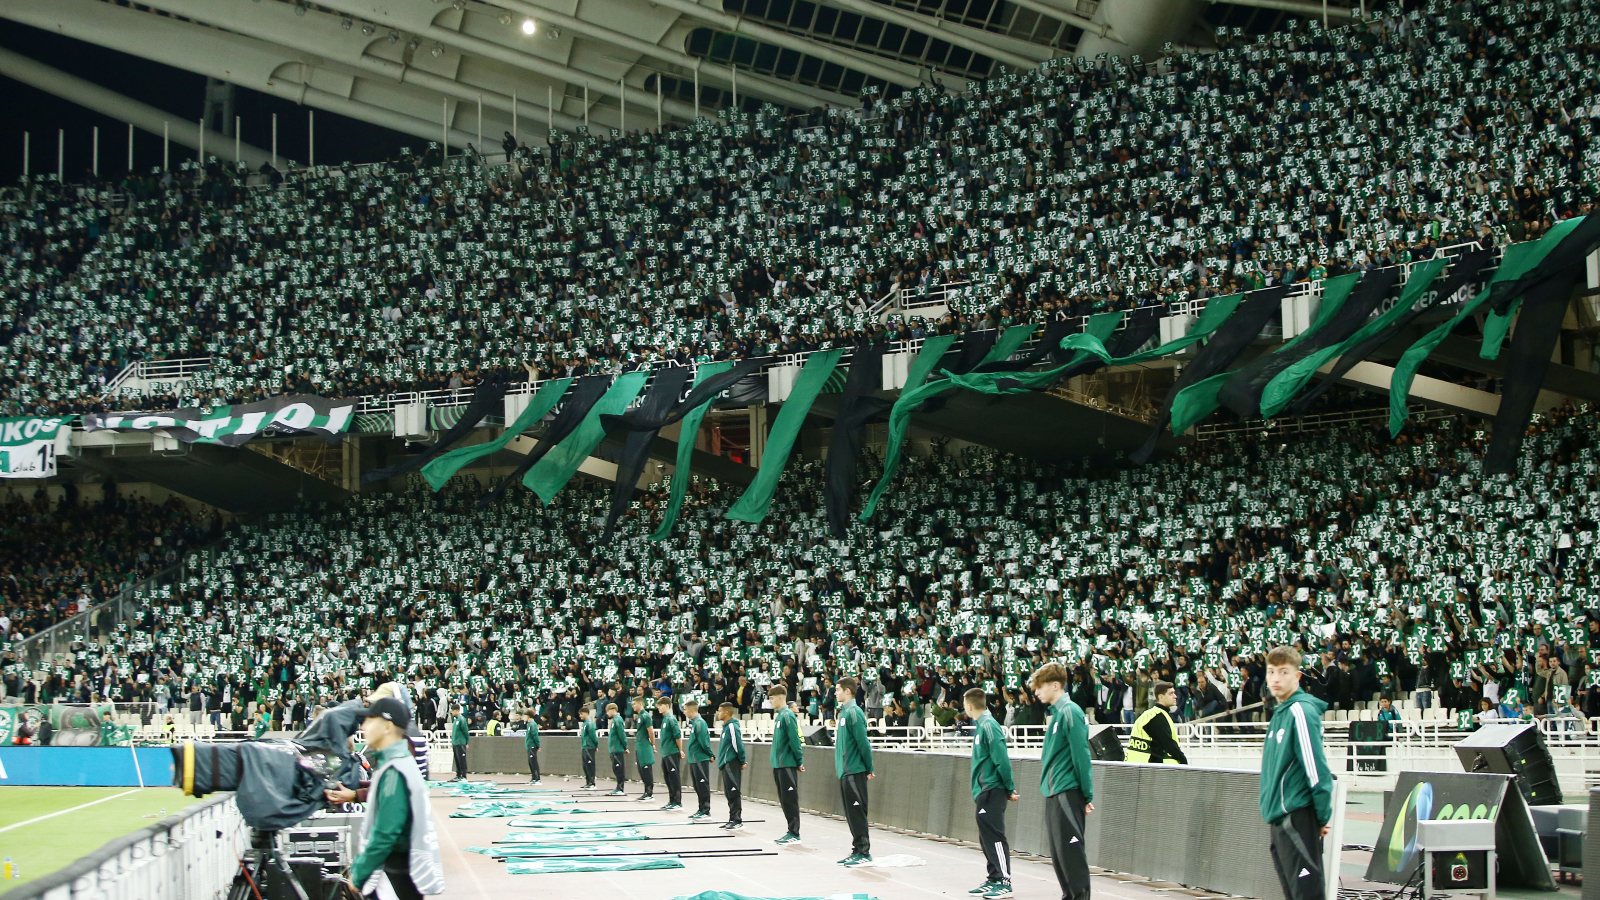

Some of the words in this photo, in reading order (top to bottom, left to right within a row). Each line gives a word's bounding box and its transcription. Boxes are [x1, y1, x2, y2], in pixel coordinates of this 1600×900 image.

[1391, 8, 1400, 16] 32
[1234, 28, 1241, 36] 32
[1438, 31, 1447, 41] 32
[1516, 27, 1525, 36] 32
[1276, 49, 1285, 58] 32
[1050, 59, 1057, 67] 32
[1132, 55, 1140, 63] 32
[1586, 54, 1595, 64] 32
[1362, 71, 1370, 80] 32
[1168, 87, 1175, 96] 32
[1309, 102, 1318, 111] 32
[1458, 97, 1466, 106] 32
[1549, 98, 1558, 108] 32
[1238, 115, 1246, 124] 32
[1407, 125, 1416, 135] 32
[1581, 124, 1592, 136] 32
[1499, 137, 1505, 147] 32
[812, 149, 819, 157] 32
[1086, 144, 1092, 153] 32
[1312, 150, 1322, 160] 32
[981, 157, 988, 165] 32
[1545, 156, 1554, 167] 32
[910, 176, 917, 184] 32
[1036, 176, 1042, 184] 32
[1247, 180, 1256, 190] 32
[1352, 188, 1360, 198] 32
[1081, 204, 1088, 212] 32
[1417, 202, 1426, 213] 32
[1498, 200, 1508, 210] 32
[877, 214, 885, 222] 32
[1300, 220, 1309, 231] 32
[981, 233, 989, 243] 32
[1034, 231, 1042, 239] 32
[1390, 229, 1399, 241] 32
[520, 237, 527, 246] 32
[733, 238, 741, 248] 32
[921, 242, 929, 251] 32
[1259, 250, 1268, 260] 32
[866, 265, 874, 274] 32
[705, 278, 713, 286] 32
[1056, 282, 1065, 291] 32
[1212, 277, 1220, 287] 32
[541, 284, 549, 293] 32
[983, 287, 992, 296] 32
[1126, 286, 1134, 295] 32
[654, 290, 662, 298] 32
[812, 325, 820, 334] 32
[927, 323, 935, 332] 32
[524, 342, 532, 351] 32
[604, 360, 610, 368] 32
[986, 463, 993, 471] 32
[1557, 466, 1565, 476] 32
[1373, 470, 1382, 480] 32
[1302, 476, 1310, 486] 32
[1493, 484, 1503, 495] 32
[922, 497, 928, 506] 32
[1090, 504, 1098, 512] 32
[1204, 506, 1211, 515] 32
[850, 513, 857, 521] 32
[981, 517, 989, 526] 32
[1562, 511, 1573, 524] 32
[580, 523, 587, 531] 32
[1164, 536, 1174, 546] 32
[1382, 532, 1390, 542] 32
[503, 550, 510, 558] 32
[686, 550, 695, 558] 32
[1027, 544, 1038, 554] 32
[1100, 552, 1109, 562] 32
[922, 564, 931, 574] 32
[1563, 568, 1576, 580] 32
[337, 577, 345, 586] 32
[638, 586, 645, 595] 32
[856, 583, 865, 592] 32
[1402, 585, 1411, 597] 32
[289, 590, 297, 598] 32
[438, 594, 446, 602] 32
[1444, 591, 1454, 604] 32
[573, 598, 581, 606] 32
[973, 598, 982, 608] 32
[1164, 594, 1176, 605] 32
[153, 607, 160, 616] 32
[1021, 605, 1030, 615] 32
[485, 618, 492, 627] 32
[826, 620, 833, 633] 32
[371, 633, 379, 642] 32
[717, 630, 724, 642] 32
[764, 635, 773, 645] 32
[867, 634, 874, 644] 32
[1175, 632, 1186, 646] 32
[1268, 628, 1278, 642] 32
[1474, 628, 1488, 642] 32
[1570, 629, 1584, 644] 32
[1224, 634, 1236, 647] 32
[1432, 636, 1443, 650] 32
[1352, 644, 1360, 658] 32
[1067, 650, 1076, 663] 32
[1208, 654, 1218, 667] 32
[1408, 652, 1420, 664] 32
[158, 660, 167, 668] 32
[954, 659, 962, 671] 32
[1377, 662, 1388, 675] 32
[594, 669, 602, 679] 32
[1453, 663, 1462, 677] 32
[452, 676, 461, 686] 32
[1007, 676, 1017, 688] 32
[300, 684, 309, 693] 32
[528, 686, 535, 696] 32
[646, 698, 654, 708] 32
[1460, 711, 1470, 728] 32
[1130, 738, 1148, 750] ARD
